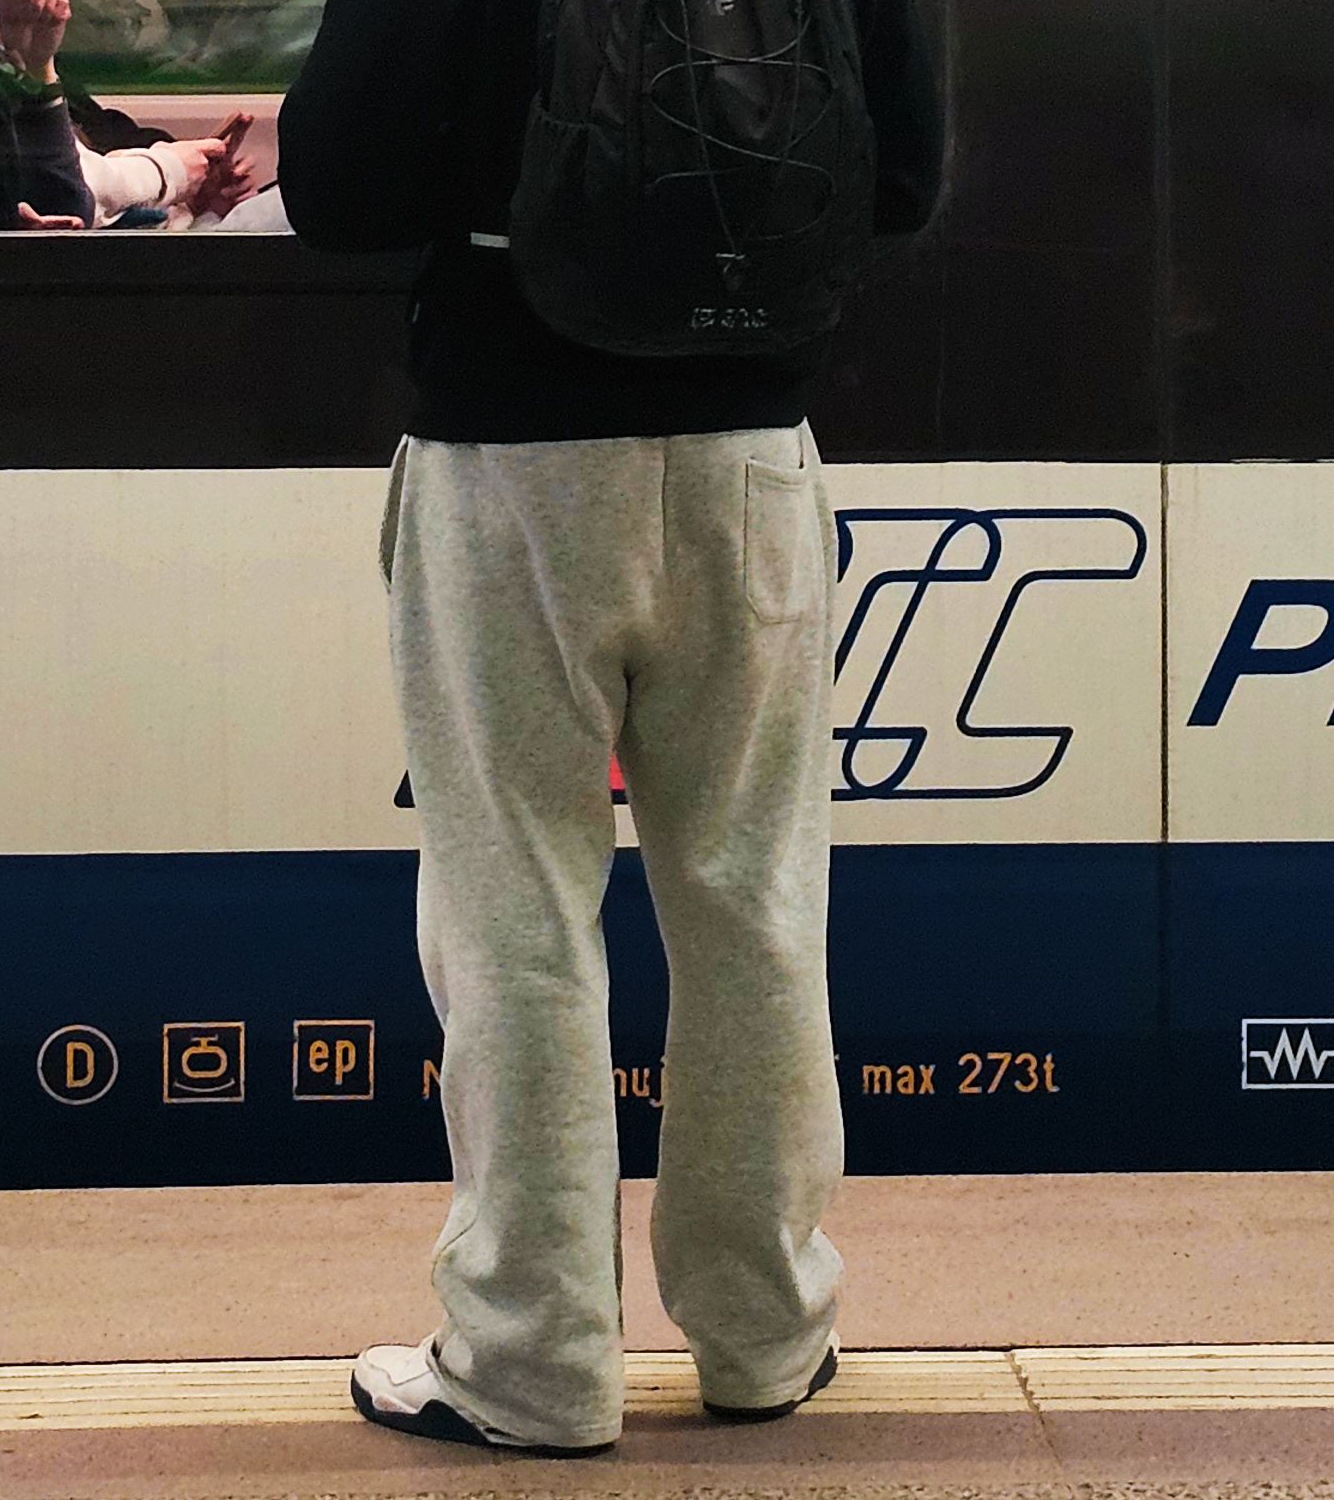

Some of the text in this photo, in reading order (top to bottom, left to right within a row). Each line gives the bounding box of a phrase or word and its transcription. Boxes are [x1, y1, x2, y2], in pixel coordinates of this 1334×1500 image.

[66, 1041, 95, 1089] D
[308, 1039, 357, 1086] ep
[862, 1051, 1061, 1095] max 273t
